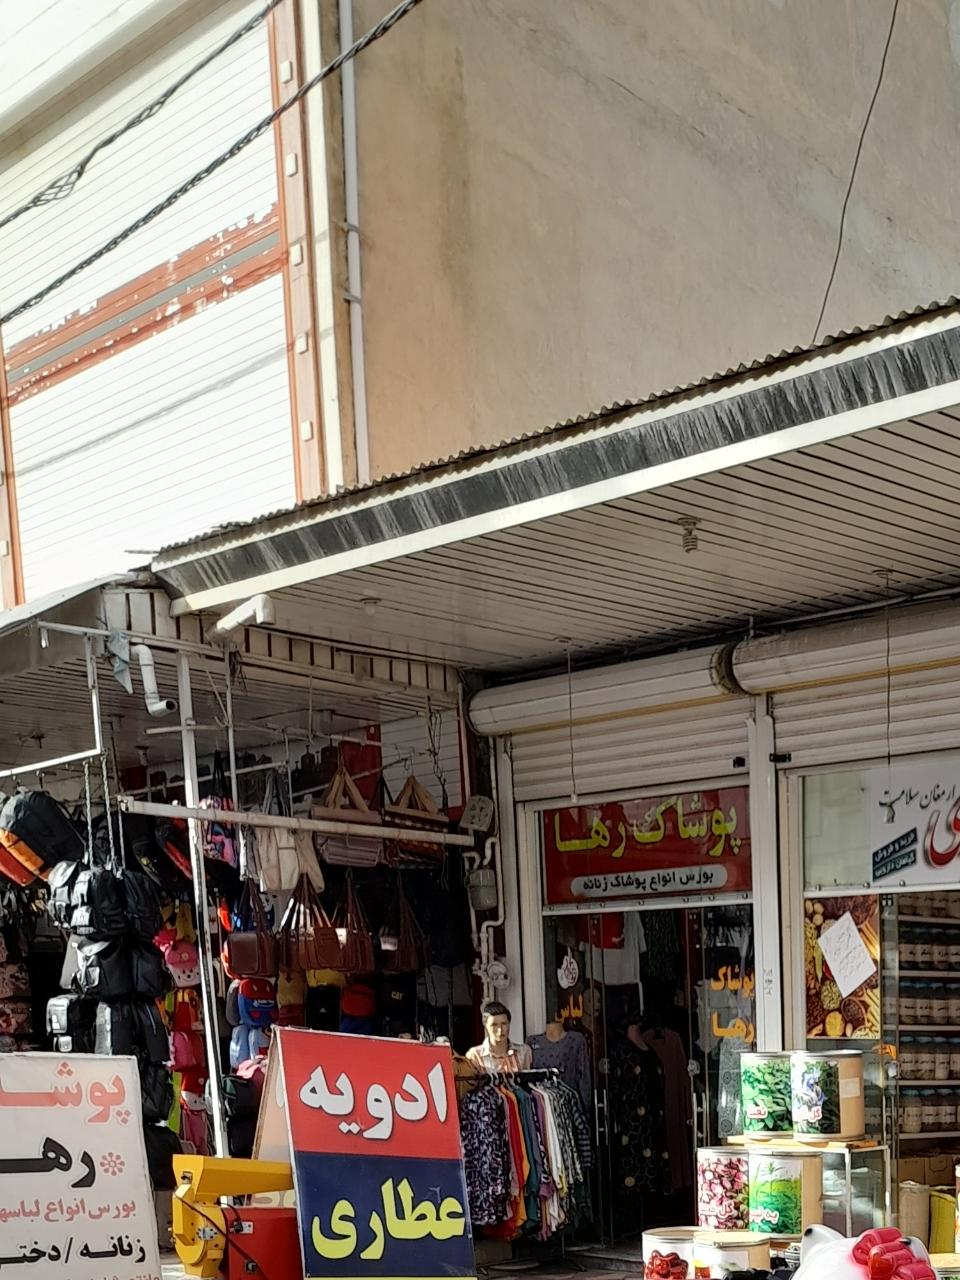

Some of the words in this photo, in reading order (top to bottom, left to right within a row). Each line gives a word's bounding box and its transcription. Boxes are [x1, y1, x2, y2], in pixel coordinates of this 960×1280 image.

[554, 810, 626, 858] رها
[632, 793, 742, 857] پوشاک
[583, 877, 608, 892] زنانه
[610, 874, 646, 891] پوشاک
[649, 870, 676, 891] انواع
[679, 871, 714, 885] بورس
[712, 1010, 755, 1043] رها
[0, 1062, 131, 1124] پوش
[300, 1061, 449, 1140] ادویه
[0, 1137, 96, 1188] ره
[44, 1198, 85, 1221] انواع
[89, 1200, 136, 1220] بورس
[311, 1177, 466, 1260] عطاری
[80, 1235, 145, 1263] زنانه
